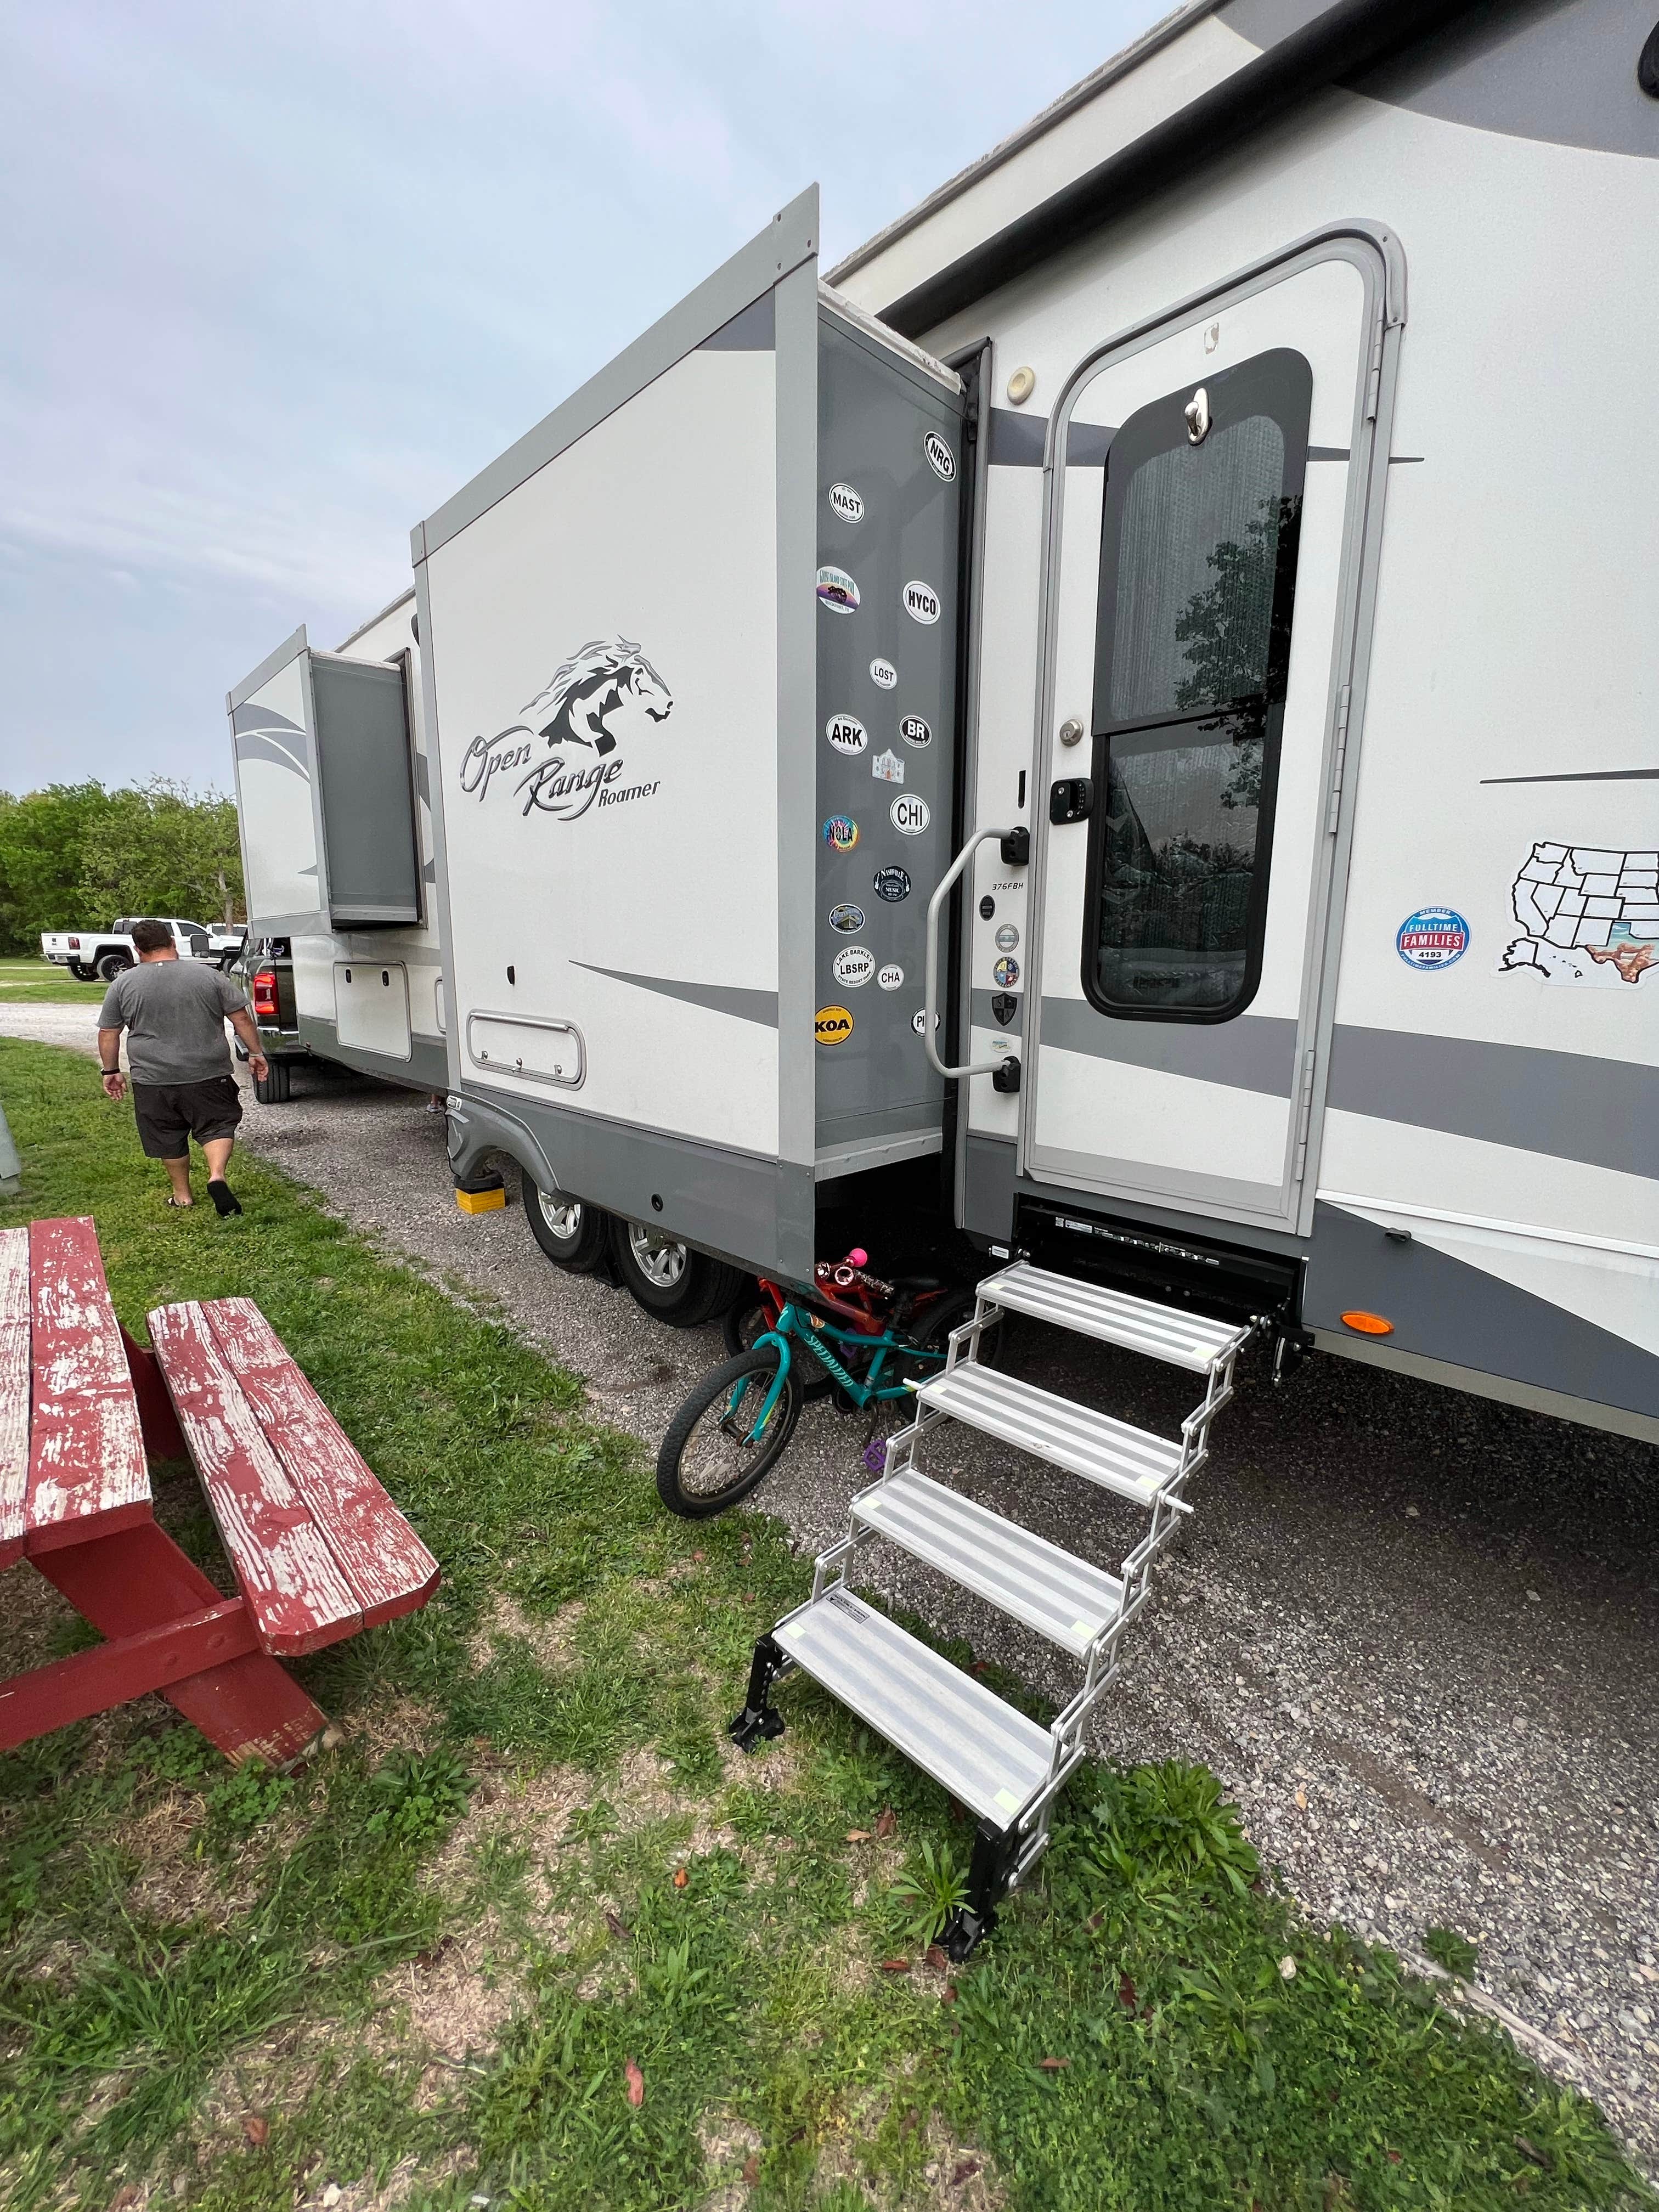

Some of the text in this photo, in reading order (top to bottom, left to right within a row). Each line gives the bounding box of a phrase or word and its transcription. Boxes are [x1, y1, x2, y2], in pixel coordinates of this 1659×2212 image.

[930, 439, 950, 473] NRG
[833, 491, 861, 514] MAST
[820, 569, 829, 583] GOOSE
[830, 573, 839, 584] ISLAND
[909, 589, 936, 616] HYCO
[874, 665, 894, 682] LOST
[831, 723, 862, 747] ARK
[907, 720, 925, 740] BR
[460, 725, 534, 802] Open
[514, 756, 623, 821] Range
[597, 781, 661, 808] Roamer
[898, 803, 923, 826] CHI
[829, 822, 853, 842] NOLA
[881, 868, 905, 881] NASHVILLE
[991, 882, 1024, 891] 376FBH
[1409, 923, 1458, 933] FULLTIME
[1403, 934, 1461, 947] FAMILIES
[836, 949, 873, 966] LAKE BARKLEY
[840, 962, 870, 975] LBSRP
[881, 972, 900, 983] CHA
[838, 974, 848, 984] STATE
[815, 1019, 851, 1033] KOA
[803, 1334, 854, 1388] SPECIALIZED
